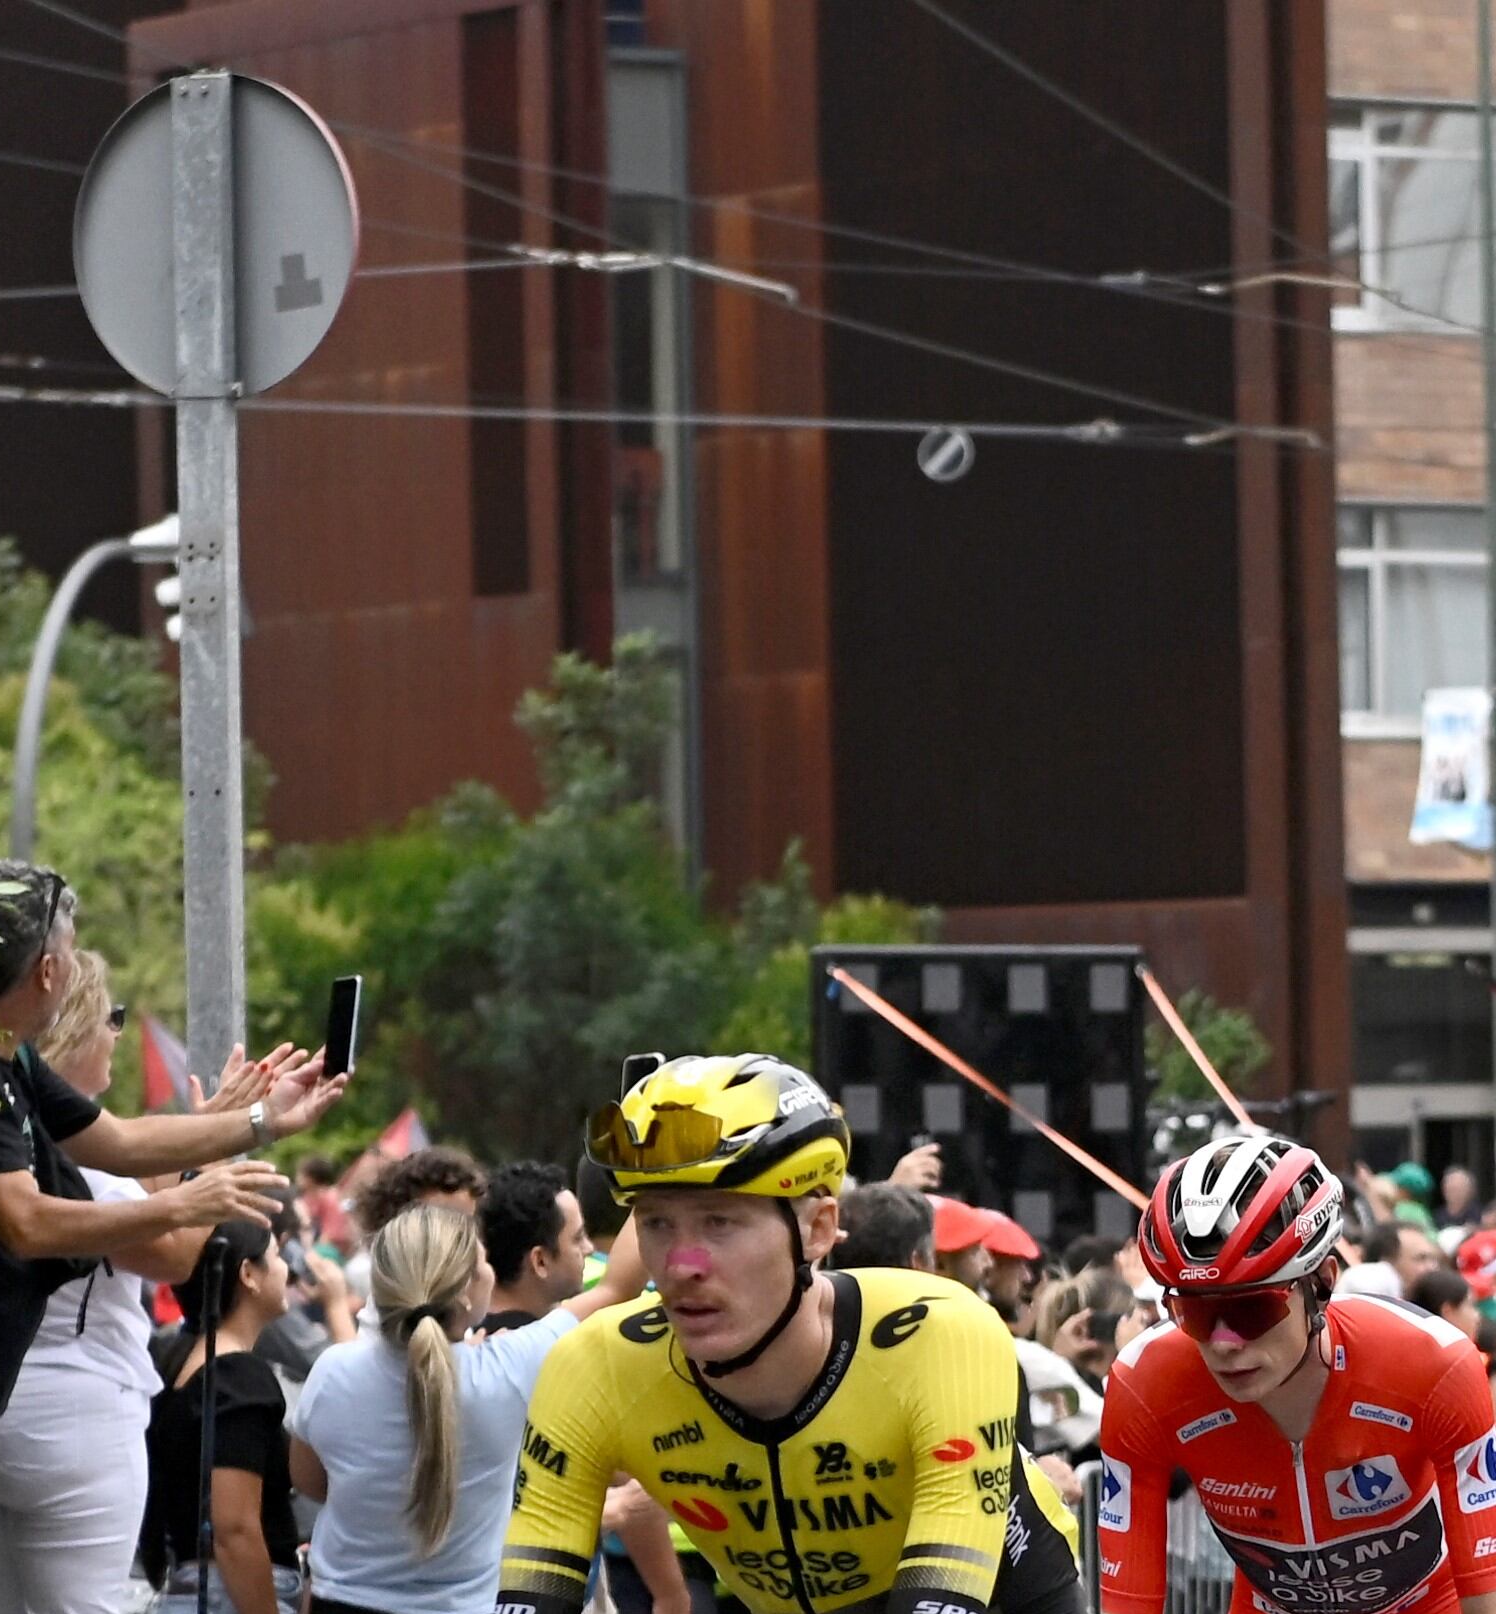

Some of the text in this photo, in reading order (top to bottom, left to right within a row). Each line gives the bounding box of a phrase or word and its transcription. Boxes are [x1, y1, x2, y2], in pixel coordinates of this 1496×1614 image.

[1179, 1266, 1220, 1281] GIRO
[652, 1420, 705, 1454] nimbl
[1199, 1477, 1277, 1501] Santini
[738, 1492, 894, 1532] VISMA
[1338, 1492, 1405, 1516] Carrefour
[1285, 1529, 1420, 1579] VISMA
